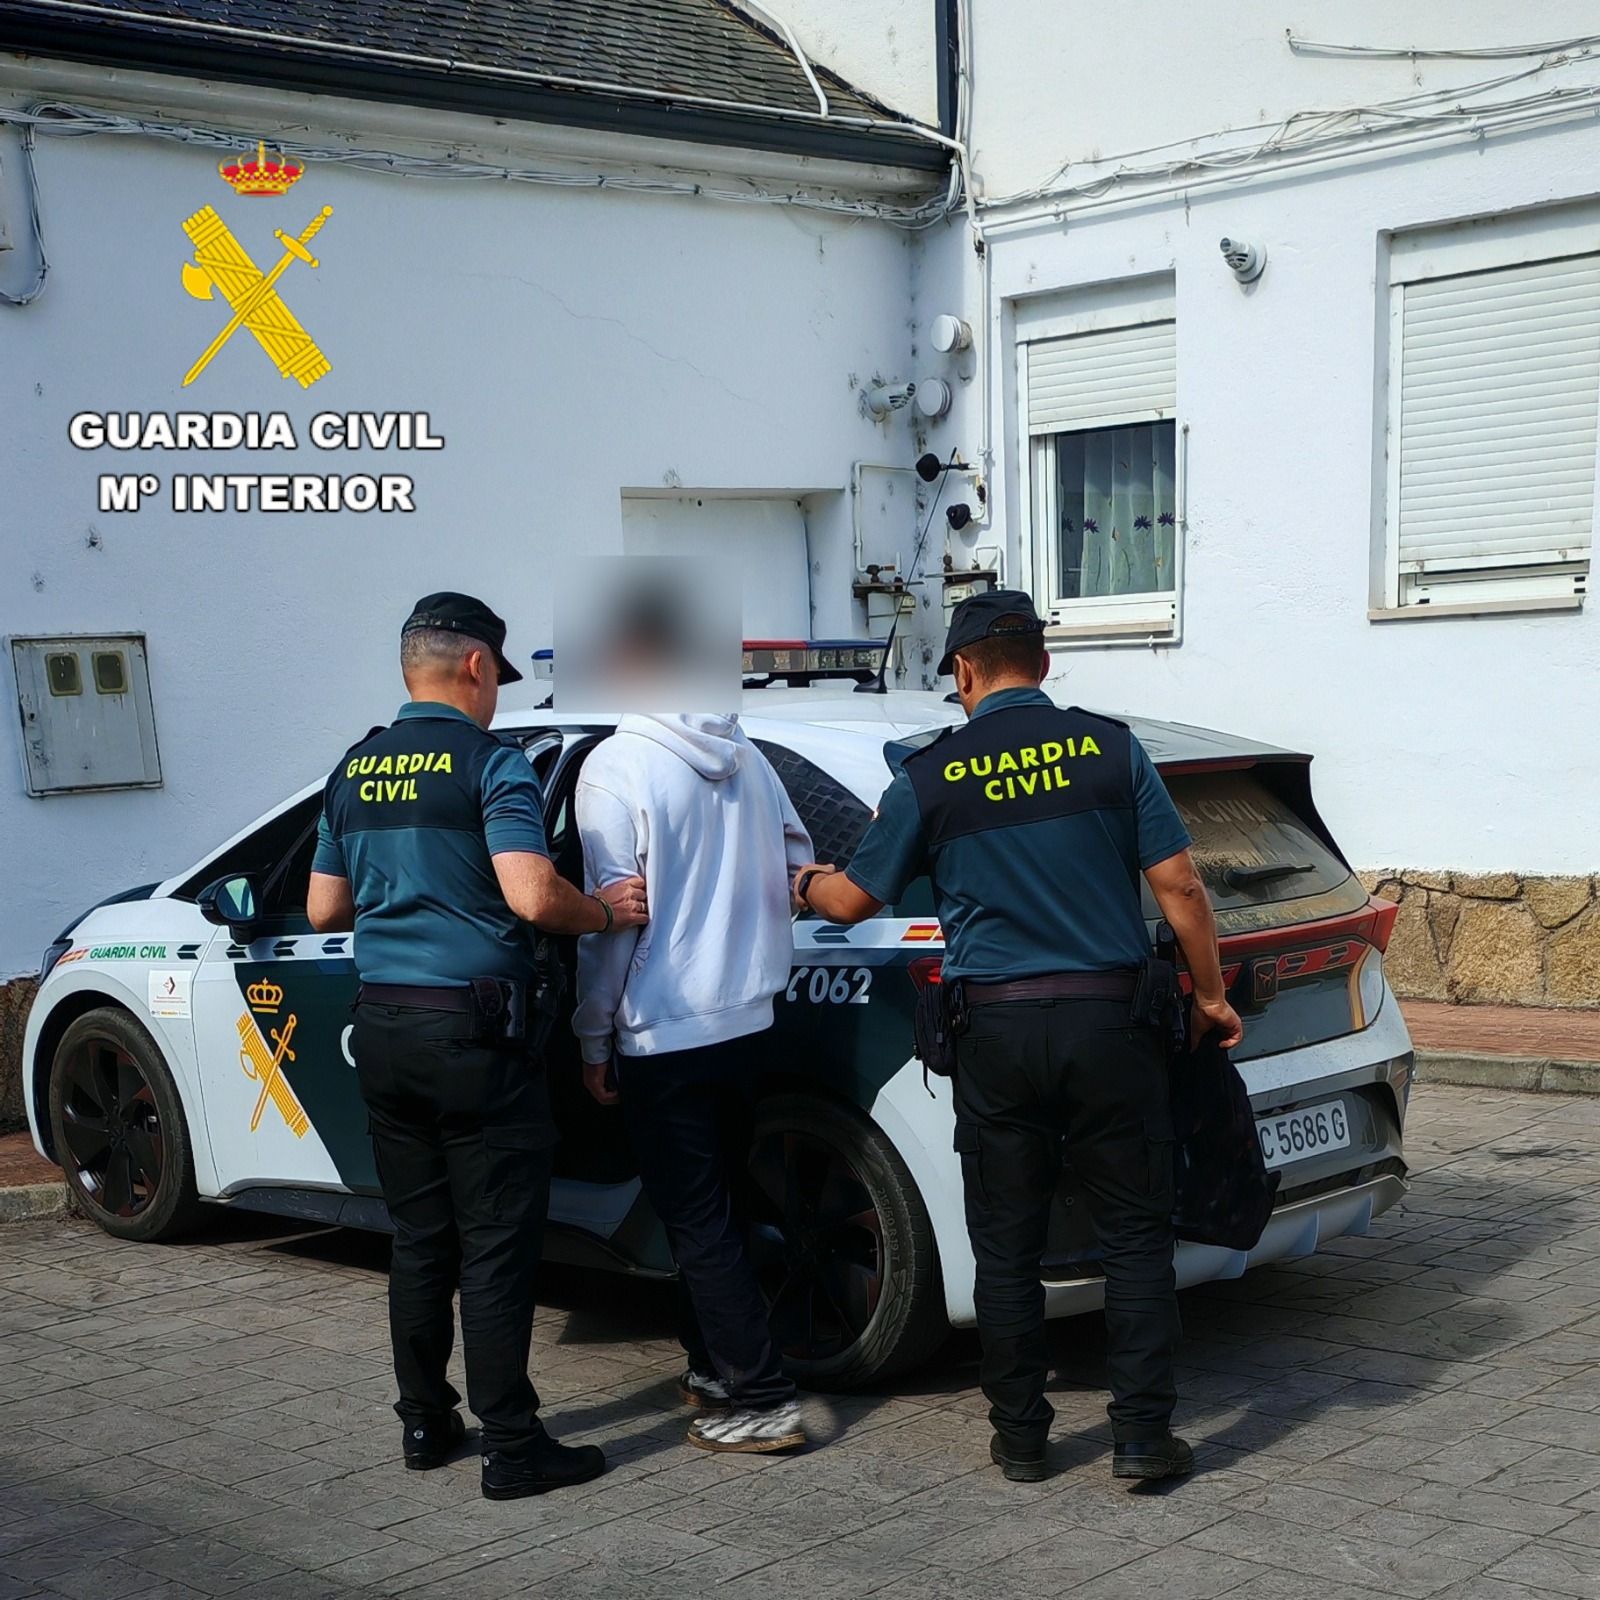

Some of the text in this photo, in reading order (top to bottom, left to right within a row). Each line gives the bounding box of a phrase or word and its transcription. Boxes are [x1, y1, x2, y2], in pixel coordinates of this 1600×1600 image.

[346, 752, 452, 779] GUARDIA
[943, 735, 1101, 782] GUARDIA
[359, 778, 418, 802] CIVIL
[984, 766, 1071, 801] CIVIL
[1197, 799, 1269, 823] CIVIL
[89, 945, 167, 959] GUARDIA CIVIL
[808, 967, 873, 1004] 062
[1275, 1111, 1329, 1156] 5686
[1331, 1107, 1345, 1141] G
